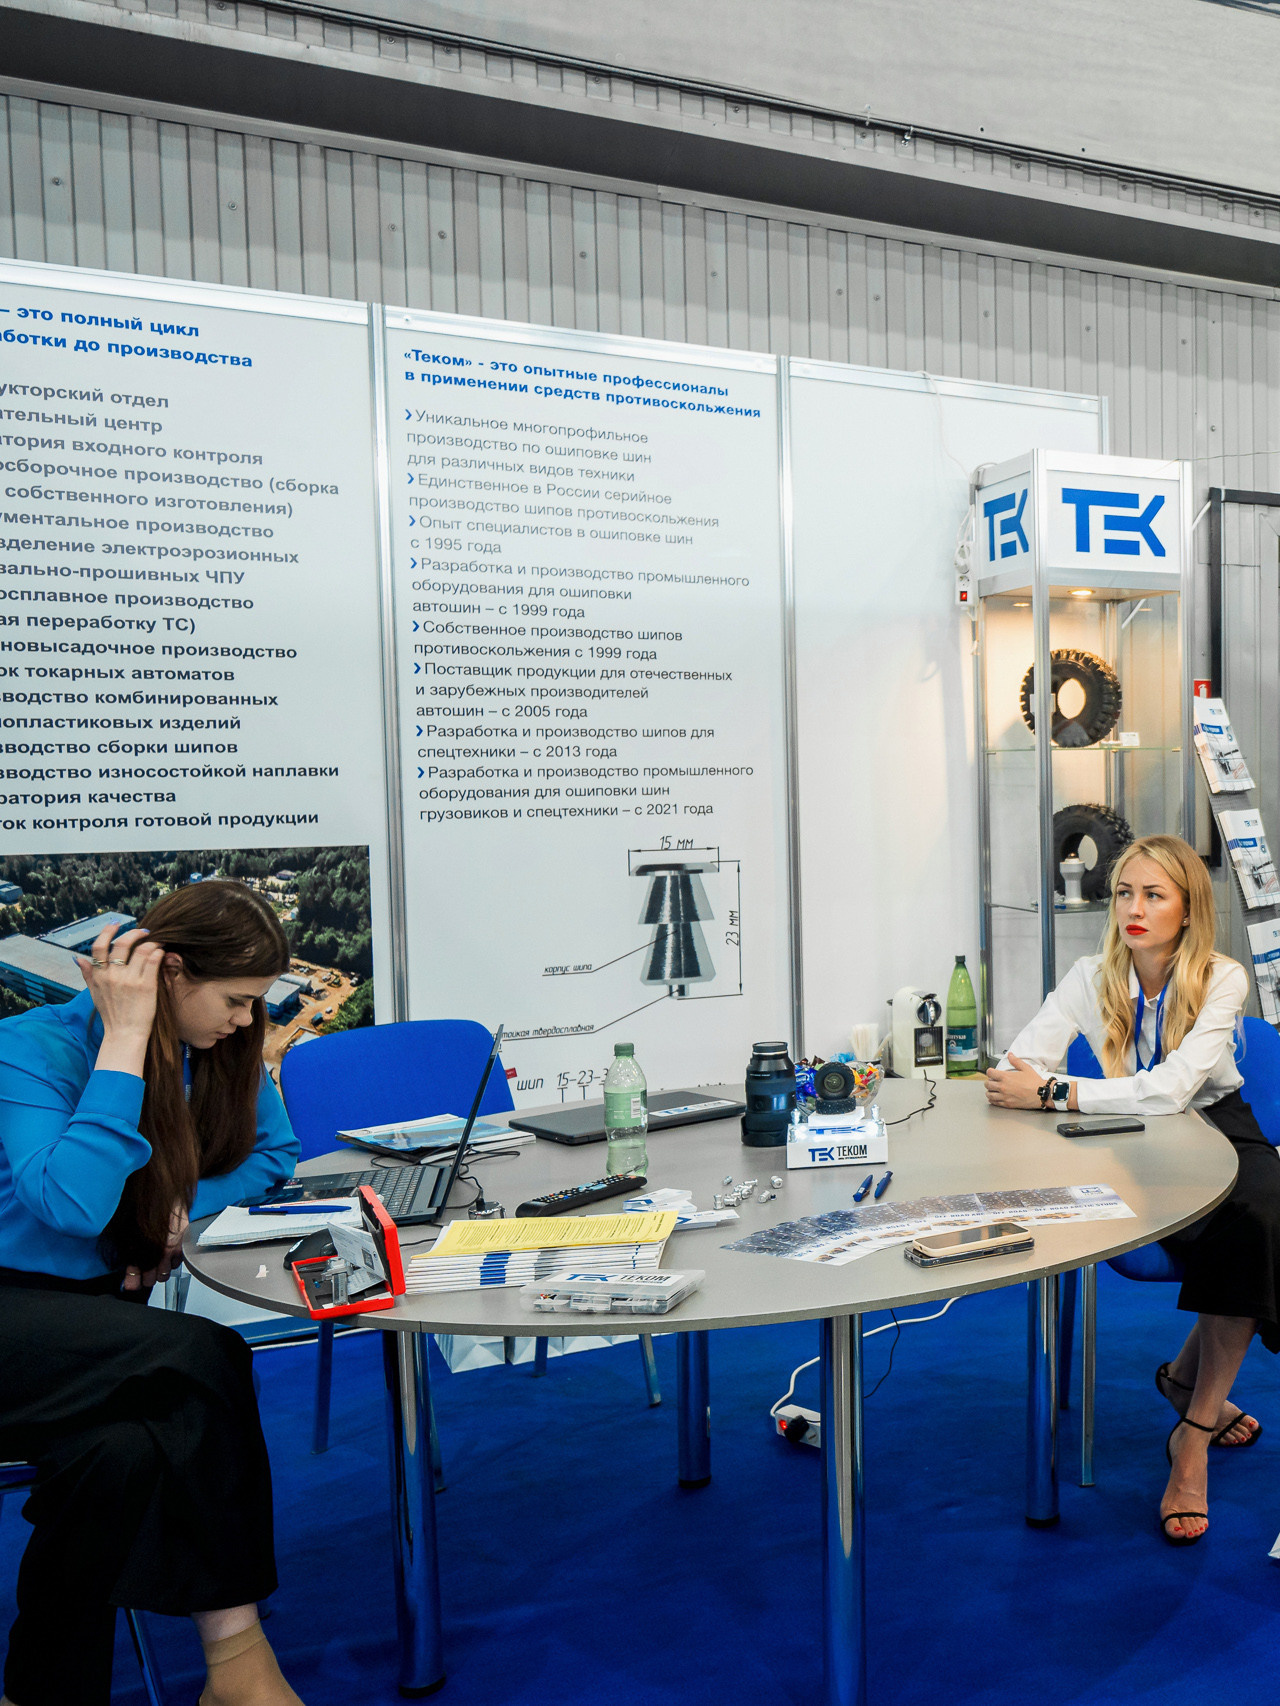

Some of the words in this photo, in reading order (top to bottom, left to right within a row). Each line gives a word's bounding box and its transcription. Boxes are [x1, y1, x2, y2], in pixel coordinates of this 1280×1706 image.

[17, 308, 53, 320] это
[61, 313, 142, 330] полный
[150, 323, 198, 336] цикл
[74, 340, 100, 352] до
[108, 343, 252, 367] производства
[404, 349, 472, 366] «Теком»
[491, 362, 517, 372] это
[524, 365, 597, 381] опытные
[603, 375, 728, 396] профессионалы
[111, 394, 168, 408] отдел
[421, 373, 528, 392] применении
[534, 386, 600, 400] средств
[606, 394, 760, 417] противоскольжения
[105, 418, 162, 435] центр
[415, 410, 508, 430] Уникальное
[514, 422, 648, 443] многопрофильное
[73, 441, 166, 457] входного
[174, 449, 262, 465] контроля
[407, 433, 517, 451] производство
[523, 444, 540, 453] по
[545, 446, 618, 460] ошиповке
[623, 453, 651, 463] шин
[407, 455, 435, 466] для
[442, 457, 524, 472] различных
[530, 465, 573, 477] видов
[578, 469, 634, 481] техники
[125, 470, 263, 489] производство
[270, 477, 338, 496] (сборка
[419, 474, 528, 493] Единственное
[547, 484, 599, 498] России
[605, 491, 671, 504] серийное
[5, 485, 148, 505] собственного
[155, 497, 292, 518] изготовления)
[410, 497, 519, 513] производство
[525, 505, 572, 516] шипов
[578, 509, 719, 527] противоскольжения
[137, 521, 273, 538] производство
[419, 516, 462, 529] Опыт
[467, 522, 572, 536] специалистов
[590, 530, 660, 542] ошиповке
[666, 535, 692, 544] шин
[102, 544, 298, 563] электроэрозионных
[426, 537, 462, 550] 1995
[468, 542, 501, 554] года
[206, 571, 244, 584] ЧПУ
[422, 558, 512, 574] Разработка
[532, 567, 633, 581] производство
[638, 572, 749, 586] промышленного
[412, 579, 523, 595] оборудования
[528, 587, 554, 598] для
[560, 588, 631, 599] ошиповки
[115, 595, 253, 610] производство
[413, 603, 480, 613] автошин
[513, 604, 547, 616] 1999
[553, 608, 585, 619] года
[27, 615, 156, 633] переработку
[163, 618, 195, 634] ТС)
[423, 621, 526, 635] Собственное
[531, 628, 633, 640] производство
[638, 632, 682, 641] шипов
[162, 646, 297, 659] производство
[415, 645, 570, 657] противоскольжения
[589, 647, 621, 658] 1999
[627, 651, 657, 661] года
[25, 668, 125, 681] токарных
[132, 670, 234, 680] автоматов
[424, 663, 512, 678] Поставщик
[518, 668, 595, 680] продукции
[600, 670, 625, 680] для
[630, 670, 732, 680] отечественных
[96, 691, 278, 707] комбинированных
[430, 684, 525, 699] зарубежных
[531, 688, 648, 699] производителей
[417, 707, 483, 716] автошин
[515, 705, 550, 717] 2005
[556, 709, 587, 719] года
[160, 716, 240, 731] изделий
[427, 725, 517, 740] Разработка
[536, 729, 637, 740] производство
[643, 729, 686, 737] шипов
[691, 729, 714, 739] для
[98, 740, 167, 756] сборки
[175, 744, 238, 753] шипов
[418, 749, 515, 760] спецтехники
[546, 746, 580, 757] 2013
[586, 749, 617, 759] года
[99, 764, 246, 778] износостойкой
[253, 767, 338, 777] наплавки
[429, 766, 519, 781] Разработка
[538, 768, 638, 780] производство
[644, 767, 753, 778] промышленного
[89, 793, 176, 803] качества
[419, 787, 529, 801] оборудования
[534, 788, 560, 799] для
[566, 788, 636, 796] ошиповки
[642, 787, 669, 795] шин
[421, 810, 508, 822] грузовиков
[527, 807, 618, 819] спецтехники
[647, 804, 677, 815] 2021
[684, 806, 713, 816] года
[33, 818, 128, 831] контроля
[135, 813, 211, 827] готовой
[219, 814, 318, 828] продукции
[659, 836, 671, 849] 15
[677, 838, 693, 849] мм
[726, 931, 739, 946] 23
[544, 966, 570, 974] корпус
[516, 1078, 544, 1091] шип
